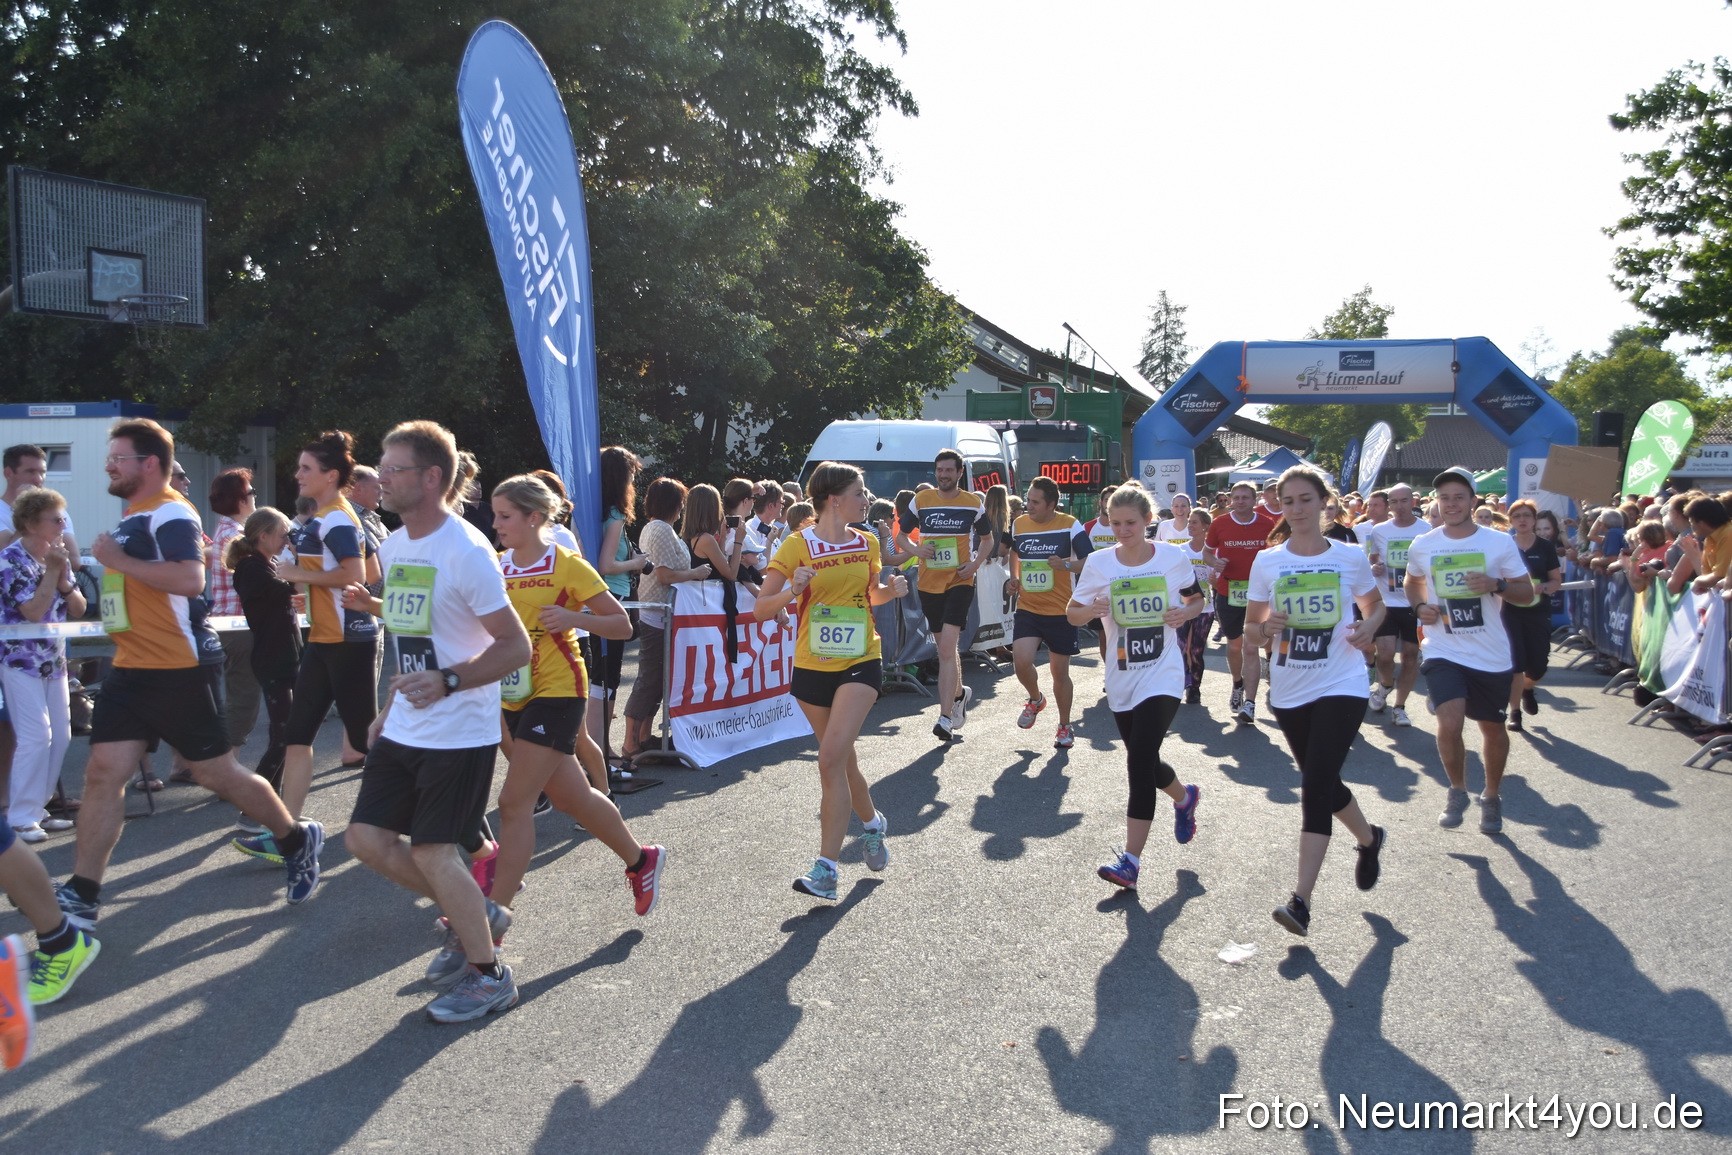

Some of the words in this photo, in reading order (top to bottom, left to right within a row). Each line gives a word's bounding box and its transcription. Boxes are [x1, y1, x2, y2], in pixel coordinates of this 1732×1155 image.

[1326, 371, 1405, 385] firmenlauf
[1180, 400, 1221, 408] Fischer
[1627, 454, 1657, 484] AOK
[930, 518, 964, 526] Fischer
[1024, 544, 1059, 552] Fischer
[812, 559, 840, 570] MAX
[844, 554, 869, 563] BÖGL
[1390, 551, 1408, 561] 115
[519, 578, 554, 589] BÖGL
[1026, 573, 1047, 585] 410
[1445, 572, 1465, 587] 52
[387, 592, 426, 615] 1157
[1117, 596, 1163, 614] 1160
[1282, 595, 1335, 615] 1155
[1452, 608, 1474, 622] RW
[820, 626, 855, 644] 867
[1131, 639, 1154, 655] RW
[1294, 635, 1321, 653] RW
[403, 653, 427, 674] RW
[1287, 662, 1328, 670] RAUMWERK
